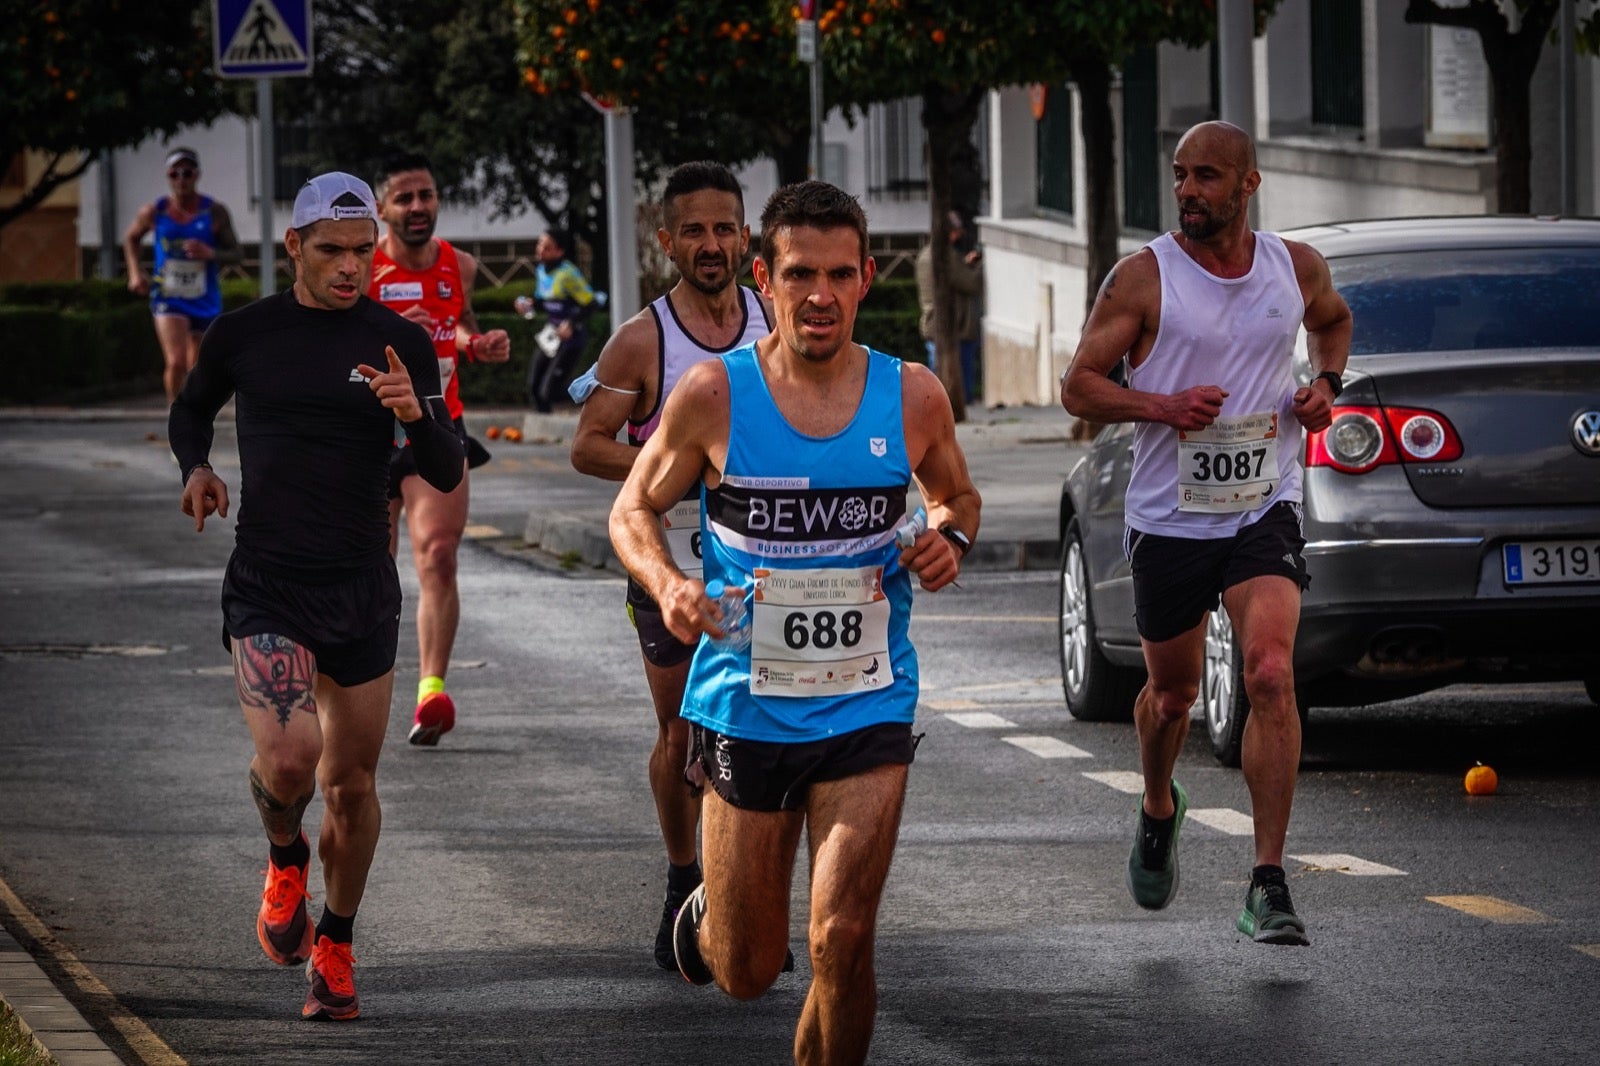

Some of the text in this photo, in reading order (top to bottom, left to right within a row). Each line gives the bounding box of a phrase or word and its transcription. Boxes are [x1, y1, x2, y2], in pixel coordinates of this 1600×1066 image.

[734, 476, 802, 487] CLUB DEPORTIVO
[1192, 448, 1267, 482] 3087
[784, 610, 863, 650] 688
